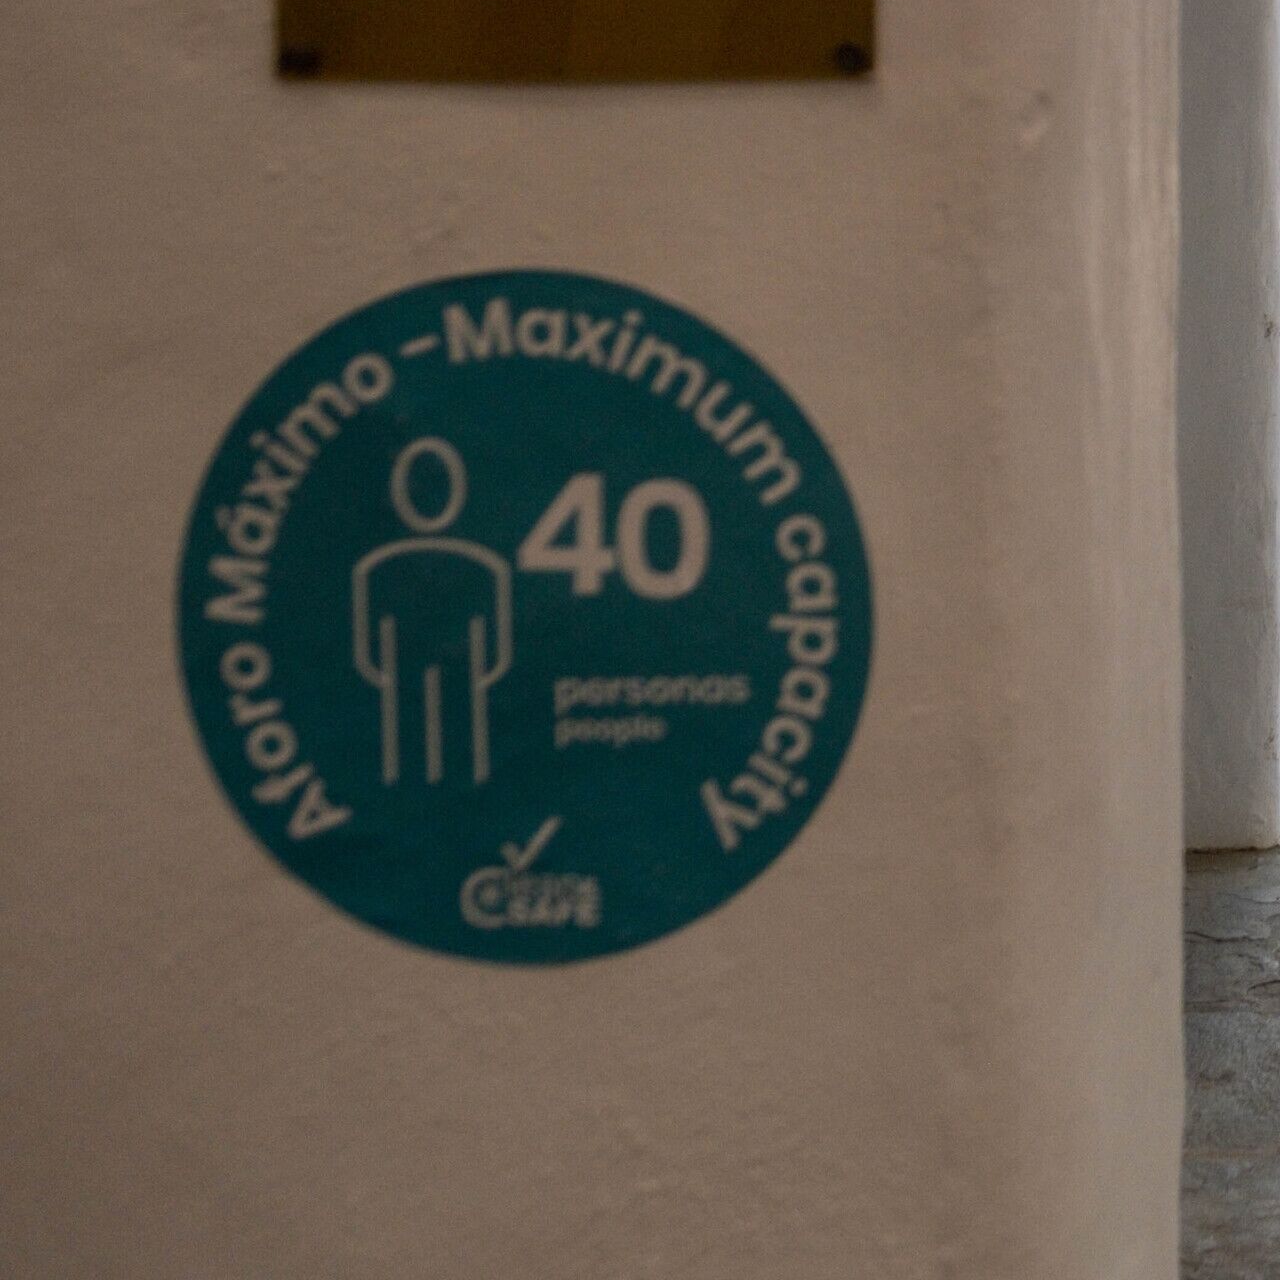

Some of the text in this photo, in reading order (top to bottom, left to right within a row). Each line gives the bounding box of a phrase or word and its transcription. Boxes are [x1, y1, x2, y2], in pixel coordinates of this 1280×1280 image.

[205, 350, 396, 626] Máximo
[518, 471, 712, 600] 40
[219, 641, 353, 843] Aforo
[700, 513, 837, 851] capacity
